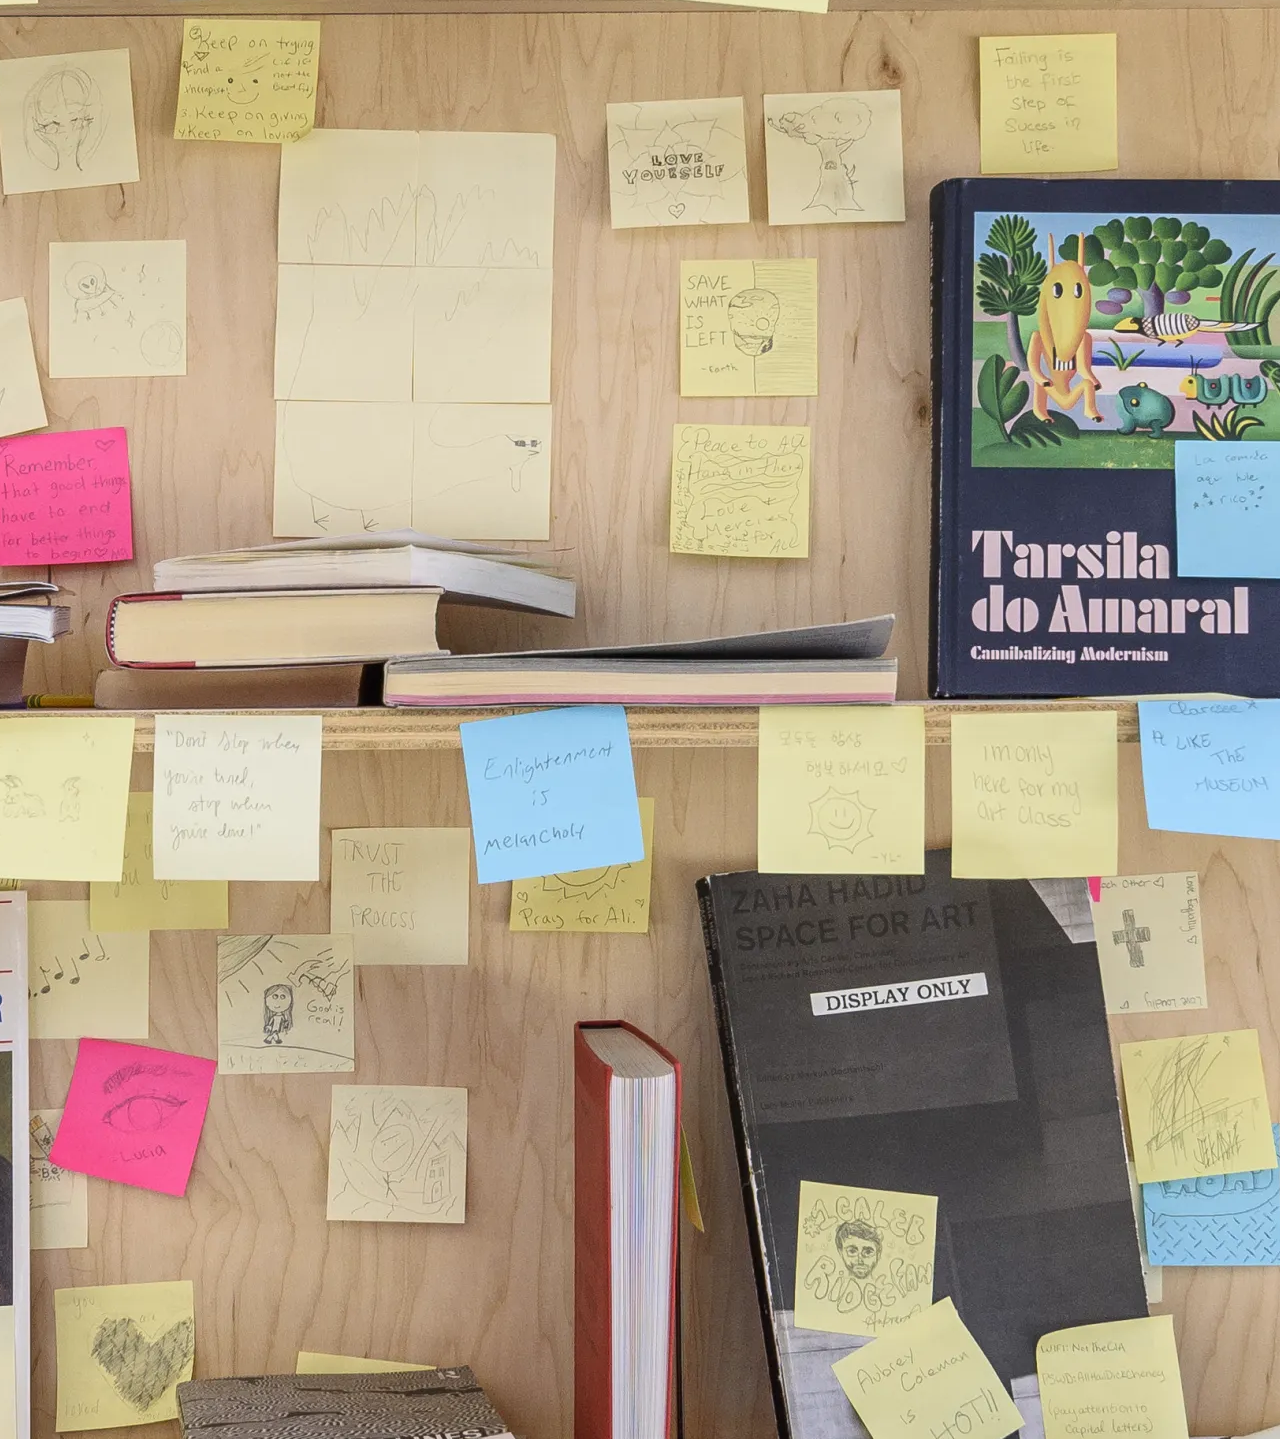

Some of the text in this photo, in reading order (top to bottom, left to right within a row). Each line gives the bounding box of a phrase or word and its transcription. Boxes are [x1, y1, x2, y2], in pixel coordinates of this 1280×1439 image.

[651, 152, 704, 167] LOVE
[623, 163, 725, 185] YOURSELF
[686, 274, 732, 291] SAVE
[684, 295, 728, 309] WHAT
[686, 315, 704, 330] IS
[685, 331, 728, 348] LEFT
[971, 530, 1170, 580] Tarsila
[971, 584, 1250, 635] do Amaral
[970, 645, 1169, 664] Cannibalizing Modernism
[484, 741, 614, 784] Enlightenment
[532, 789, 550, 807] is
[340, 839, 406, 864] TRUST
[367, 870, 404, 893] THE
[732, 877, 927, 915] ZAHA HADID
[349, 903, 418, 932] PROCESS
[736, 902, 979, 952] SPACE FOR ART
[825, 979, 971, 1012] DISPLAY ONLY
